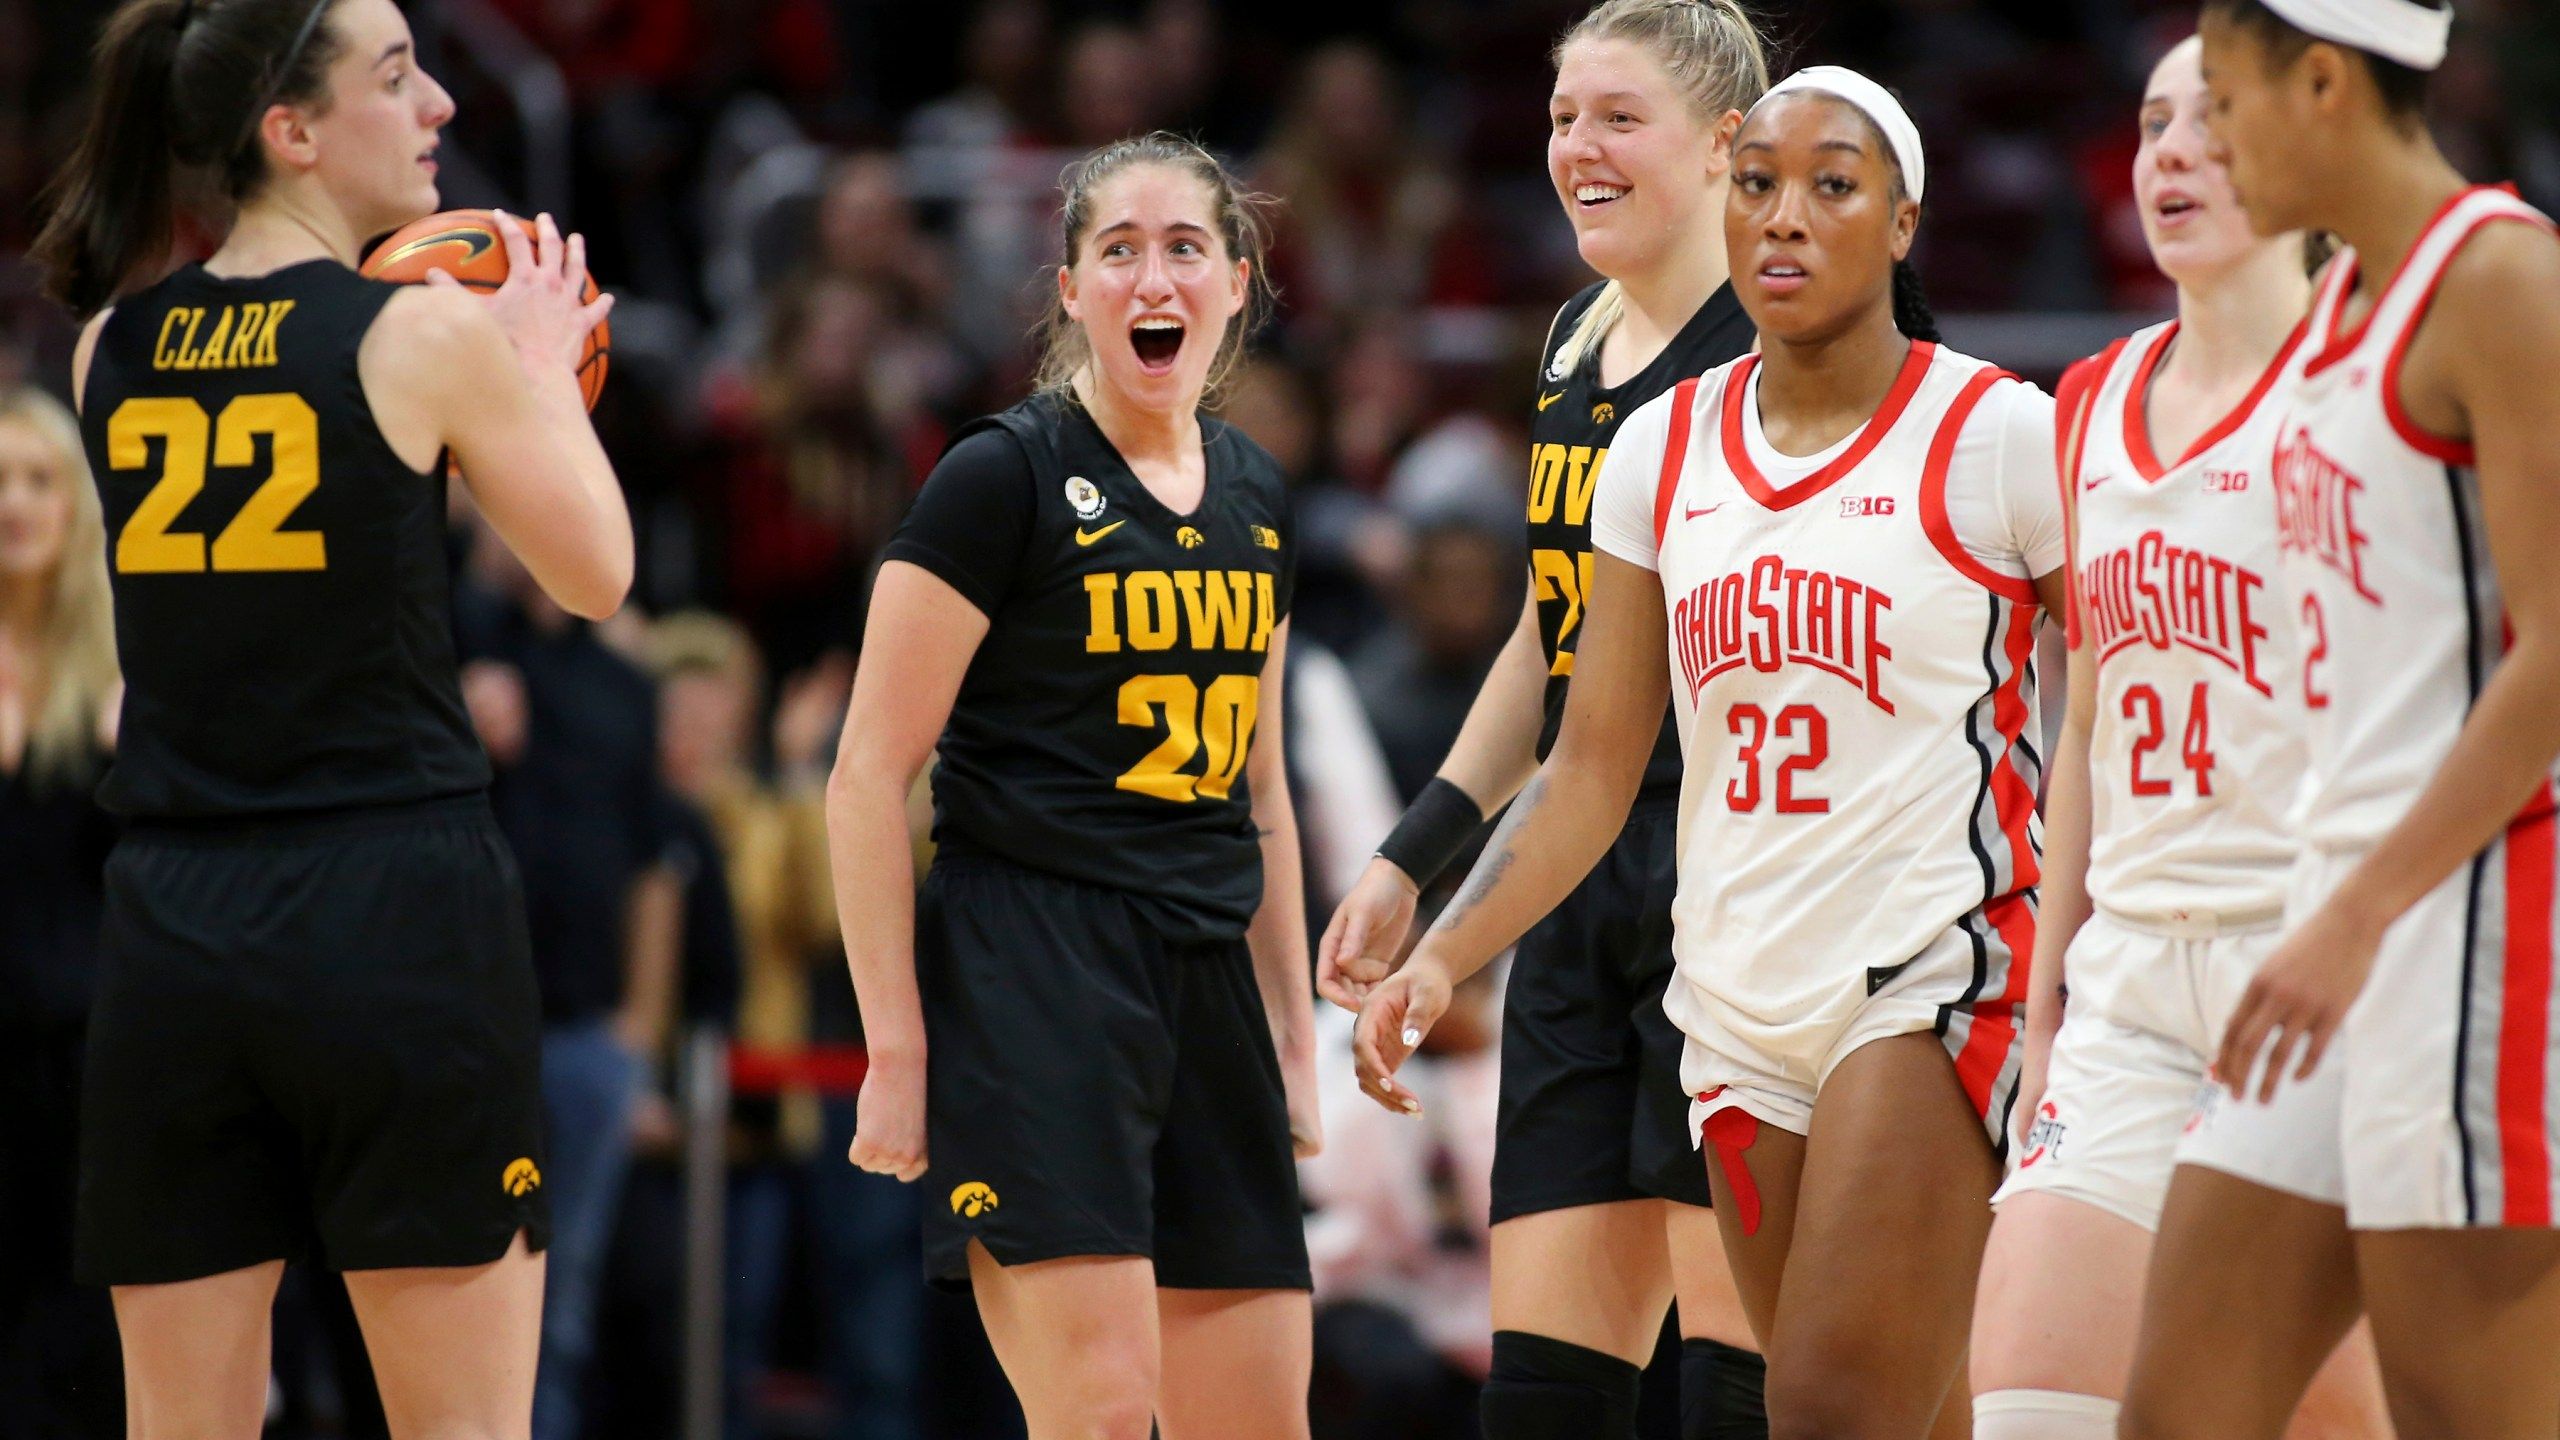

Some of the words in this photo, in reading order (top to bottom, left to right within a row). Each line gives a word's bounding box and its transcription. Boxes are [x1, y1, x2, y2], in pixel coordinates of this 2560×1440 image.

[153, 299, 296, 371] CLARK
[107, 392, 327, 574] 22
[1084, 570, 1275, 653] IOWA
[1115, 673, 1260, 803] 20
[1725, 702, 1830, 814] 32
[2121, 682, 2215, 797] 24
